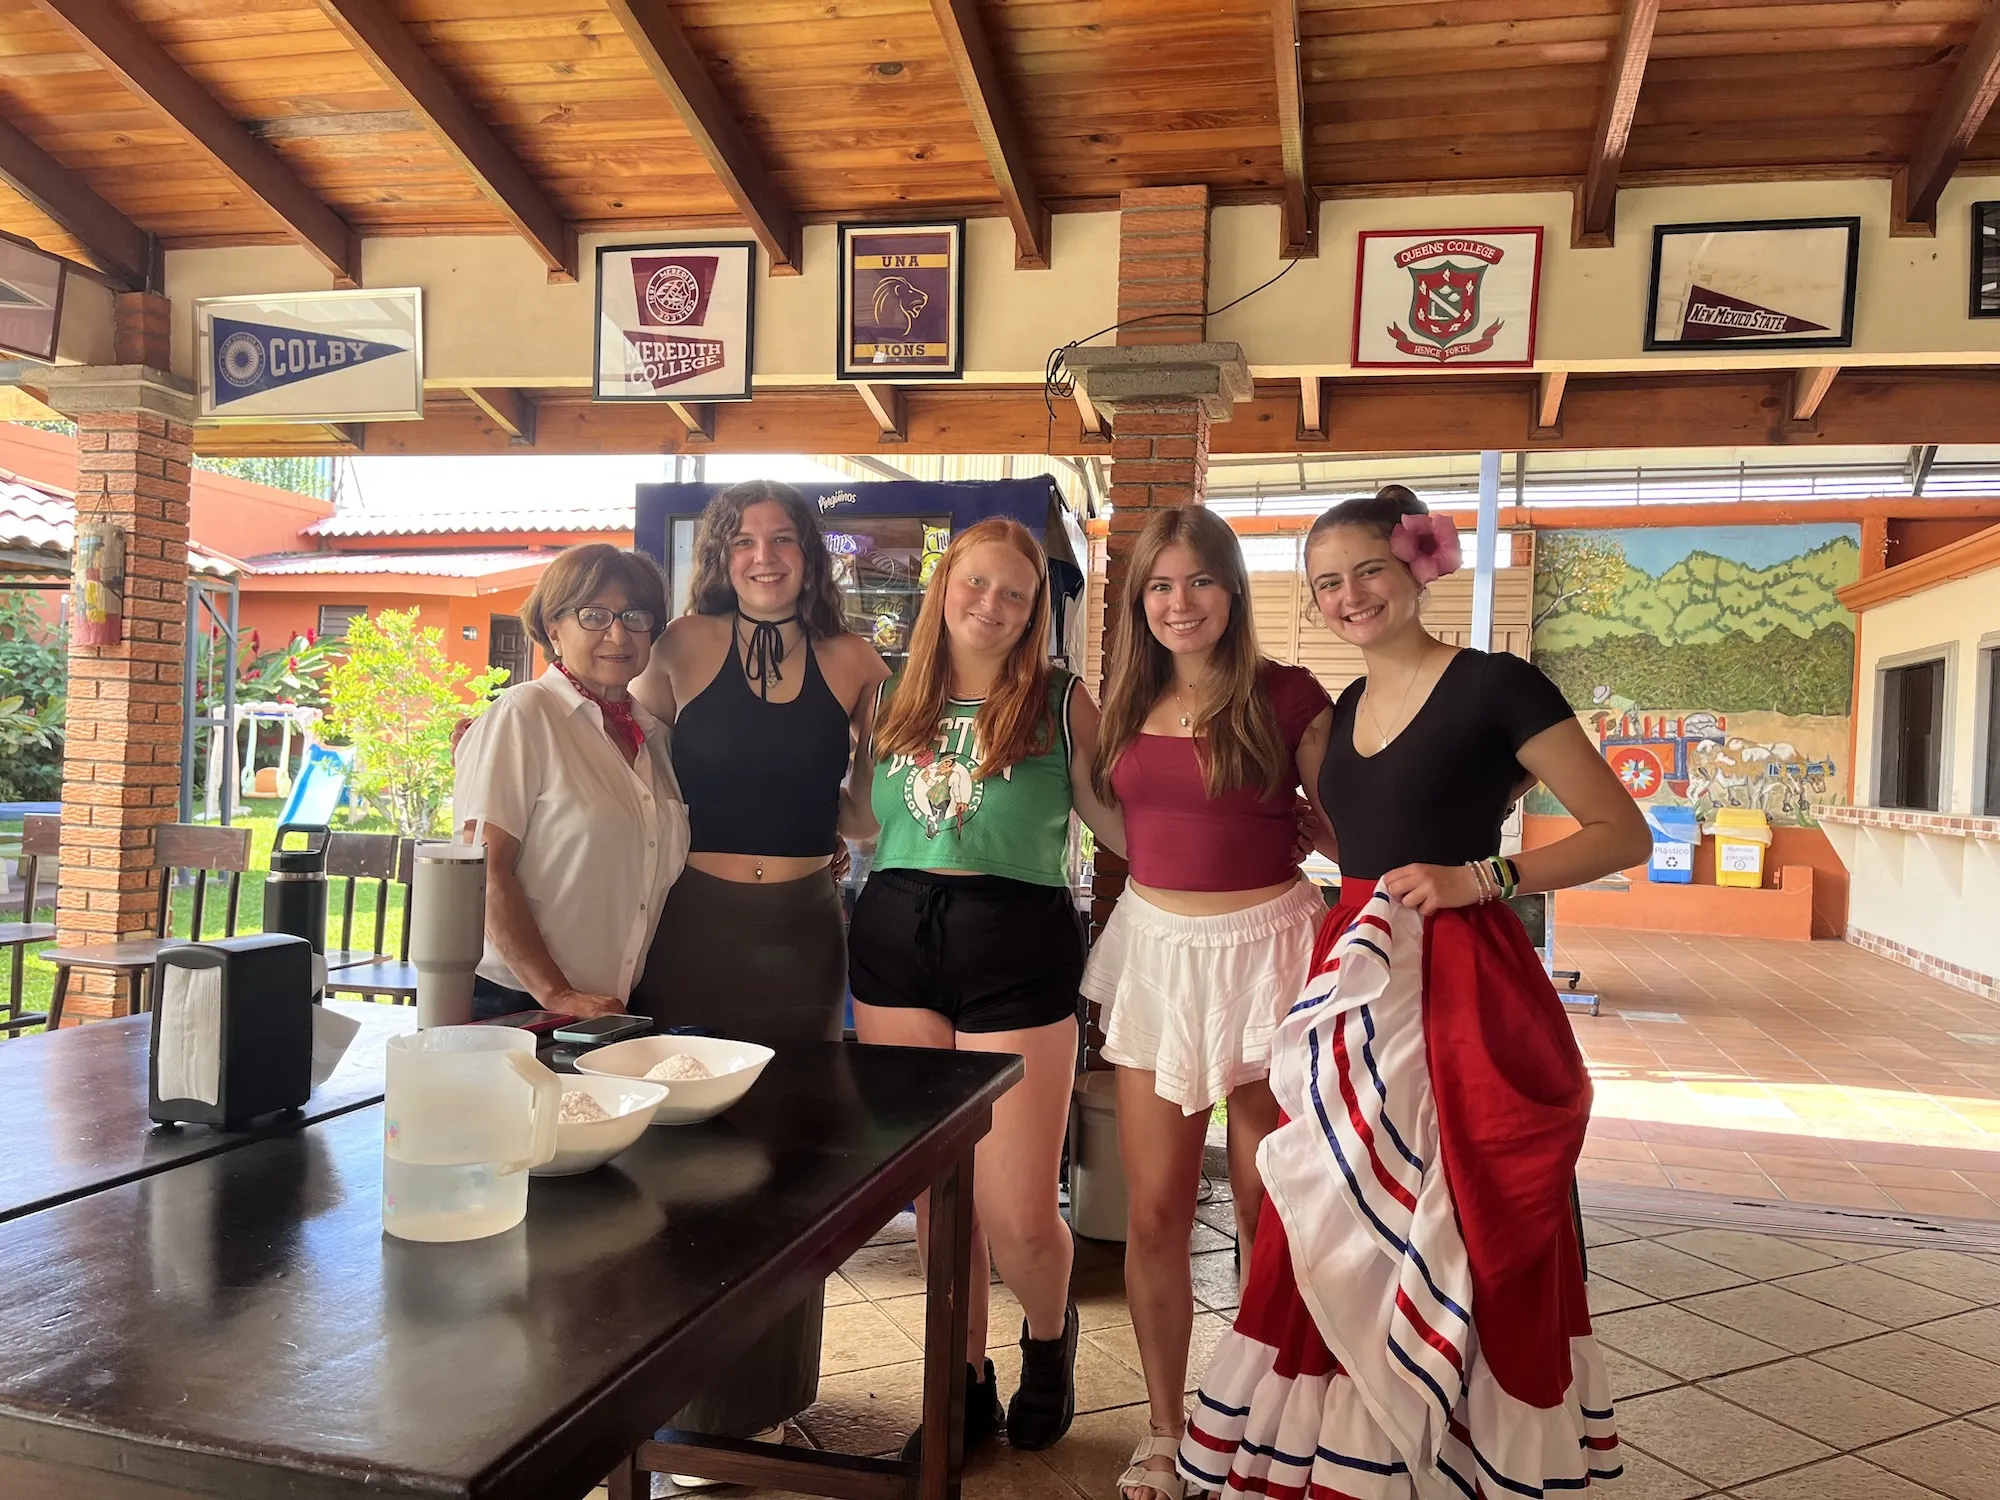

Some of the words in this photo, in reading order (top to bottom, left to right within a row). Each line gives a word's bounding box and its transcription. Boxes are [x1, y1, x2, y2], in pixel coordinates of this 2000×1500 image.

[1446, 241, 1496, 258] COLLEGE
[881, 256, 919, 267] UNA
[659, 269, 695, 290] MEREDITH
[659, 300, 695, 320] COLLEGE
[269, 338, 368, 377] COLBY
[625, 341, 721, 364] MEREDITH
[1414, 345, 1441, 357] HENCE
[1445, 344, 1470, 357] FORTH
[817, 489, 857, 513] Pingüinos
[823, 534, 858, 554] hips
[926, 532, 950, 552] Chi
[886, 716, 1012, 781] BST
[904, 767, 922, 820] BOSTON
[965, 760, 984, 812] CTICS
[1655, 847, 1689, 856] Plástico
